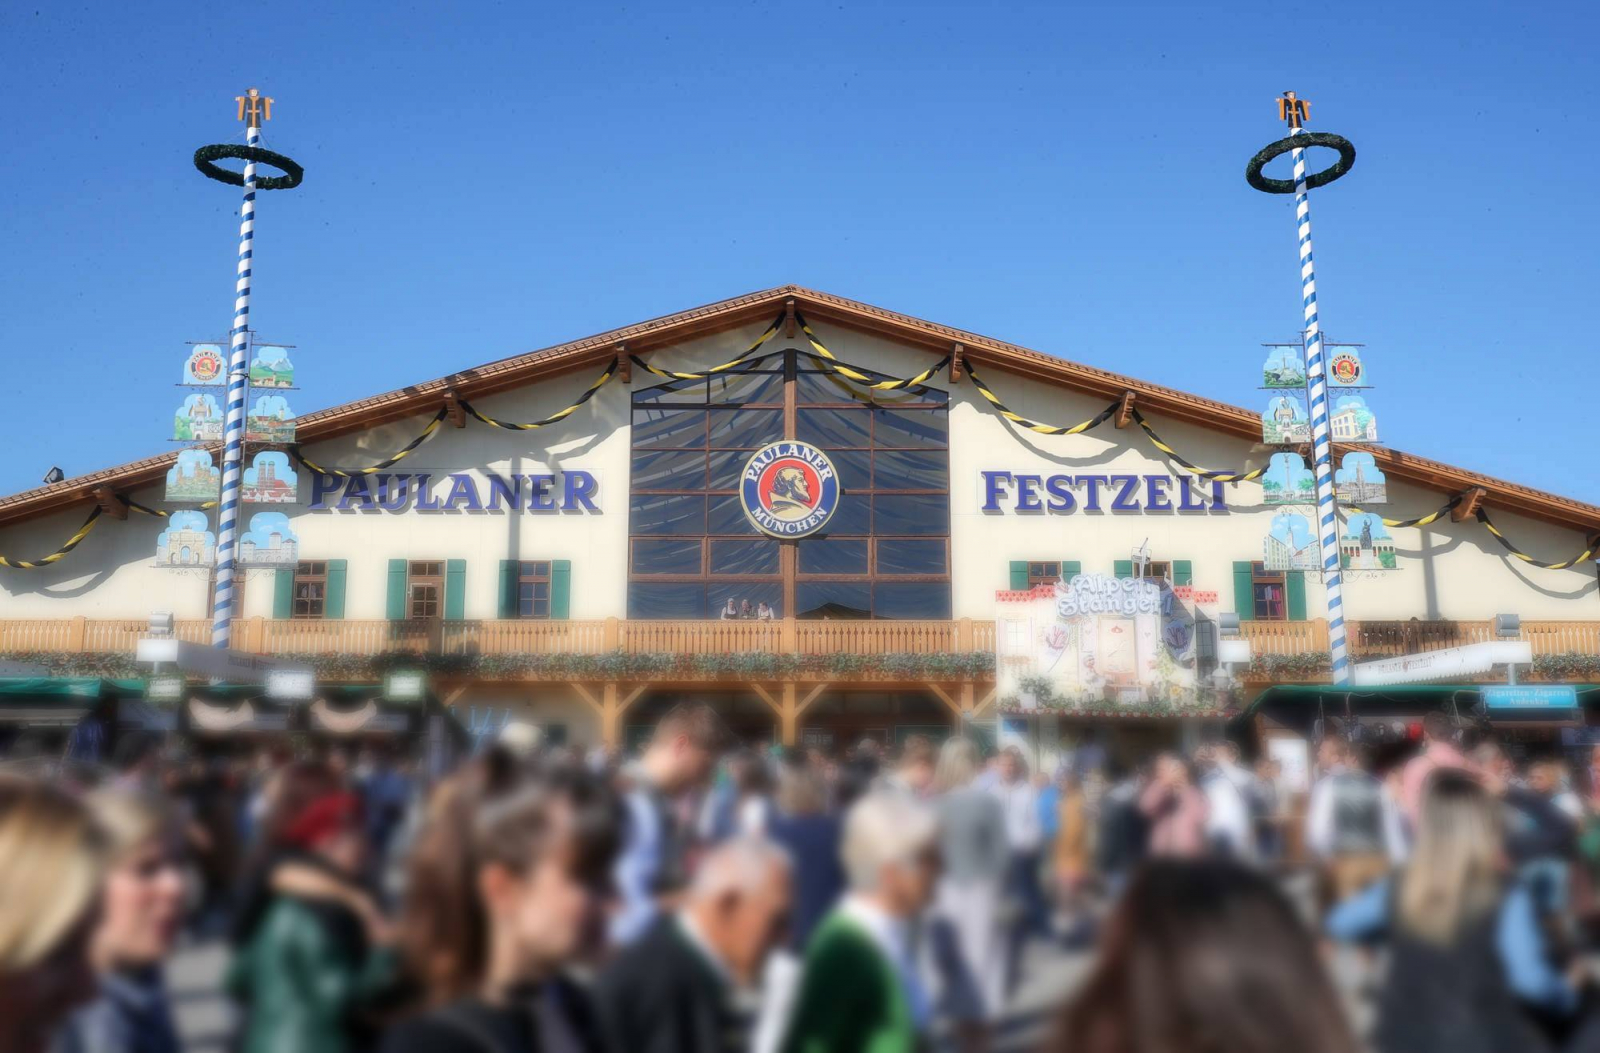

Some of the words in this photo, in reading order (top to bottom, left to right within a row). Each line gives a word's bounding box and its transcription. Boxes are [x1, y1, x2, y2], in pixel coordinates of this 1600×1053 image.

[745, 444, 833, 483] PAULANER
[307, 469, 600, 511] PAULANER
[981, 470, 1236, 512] FESTZELT
[1074, 574, 1153, 598] Alpen
[1534, 688, 1570, 698] Zigarren
